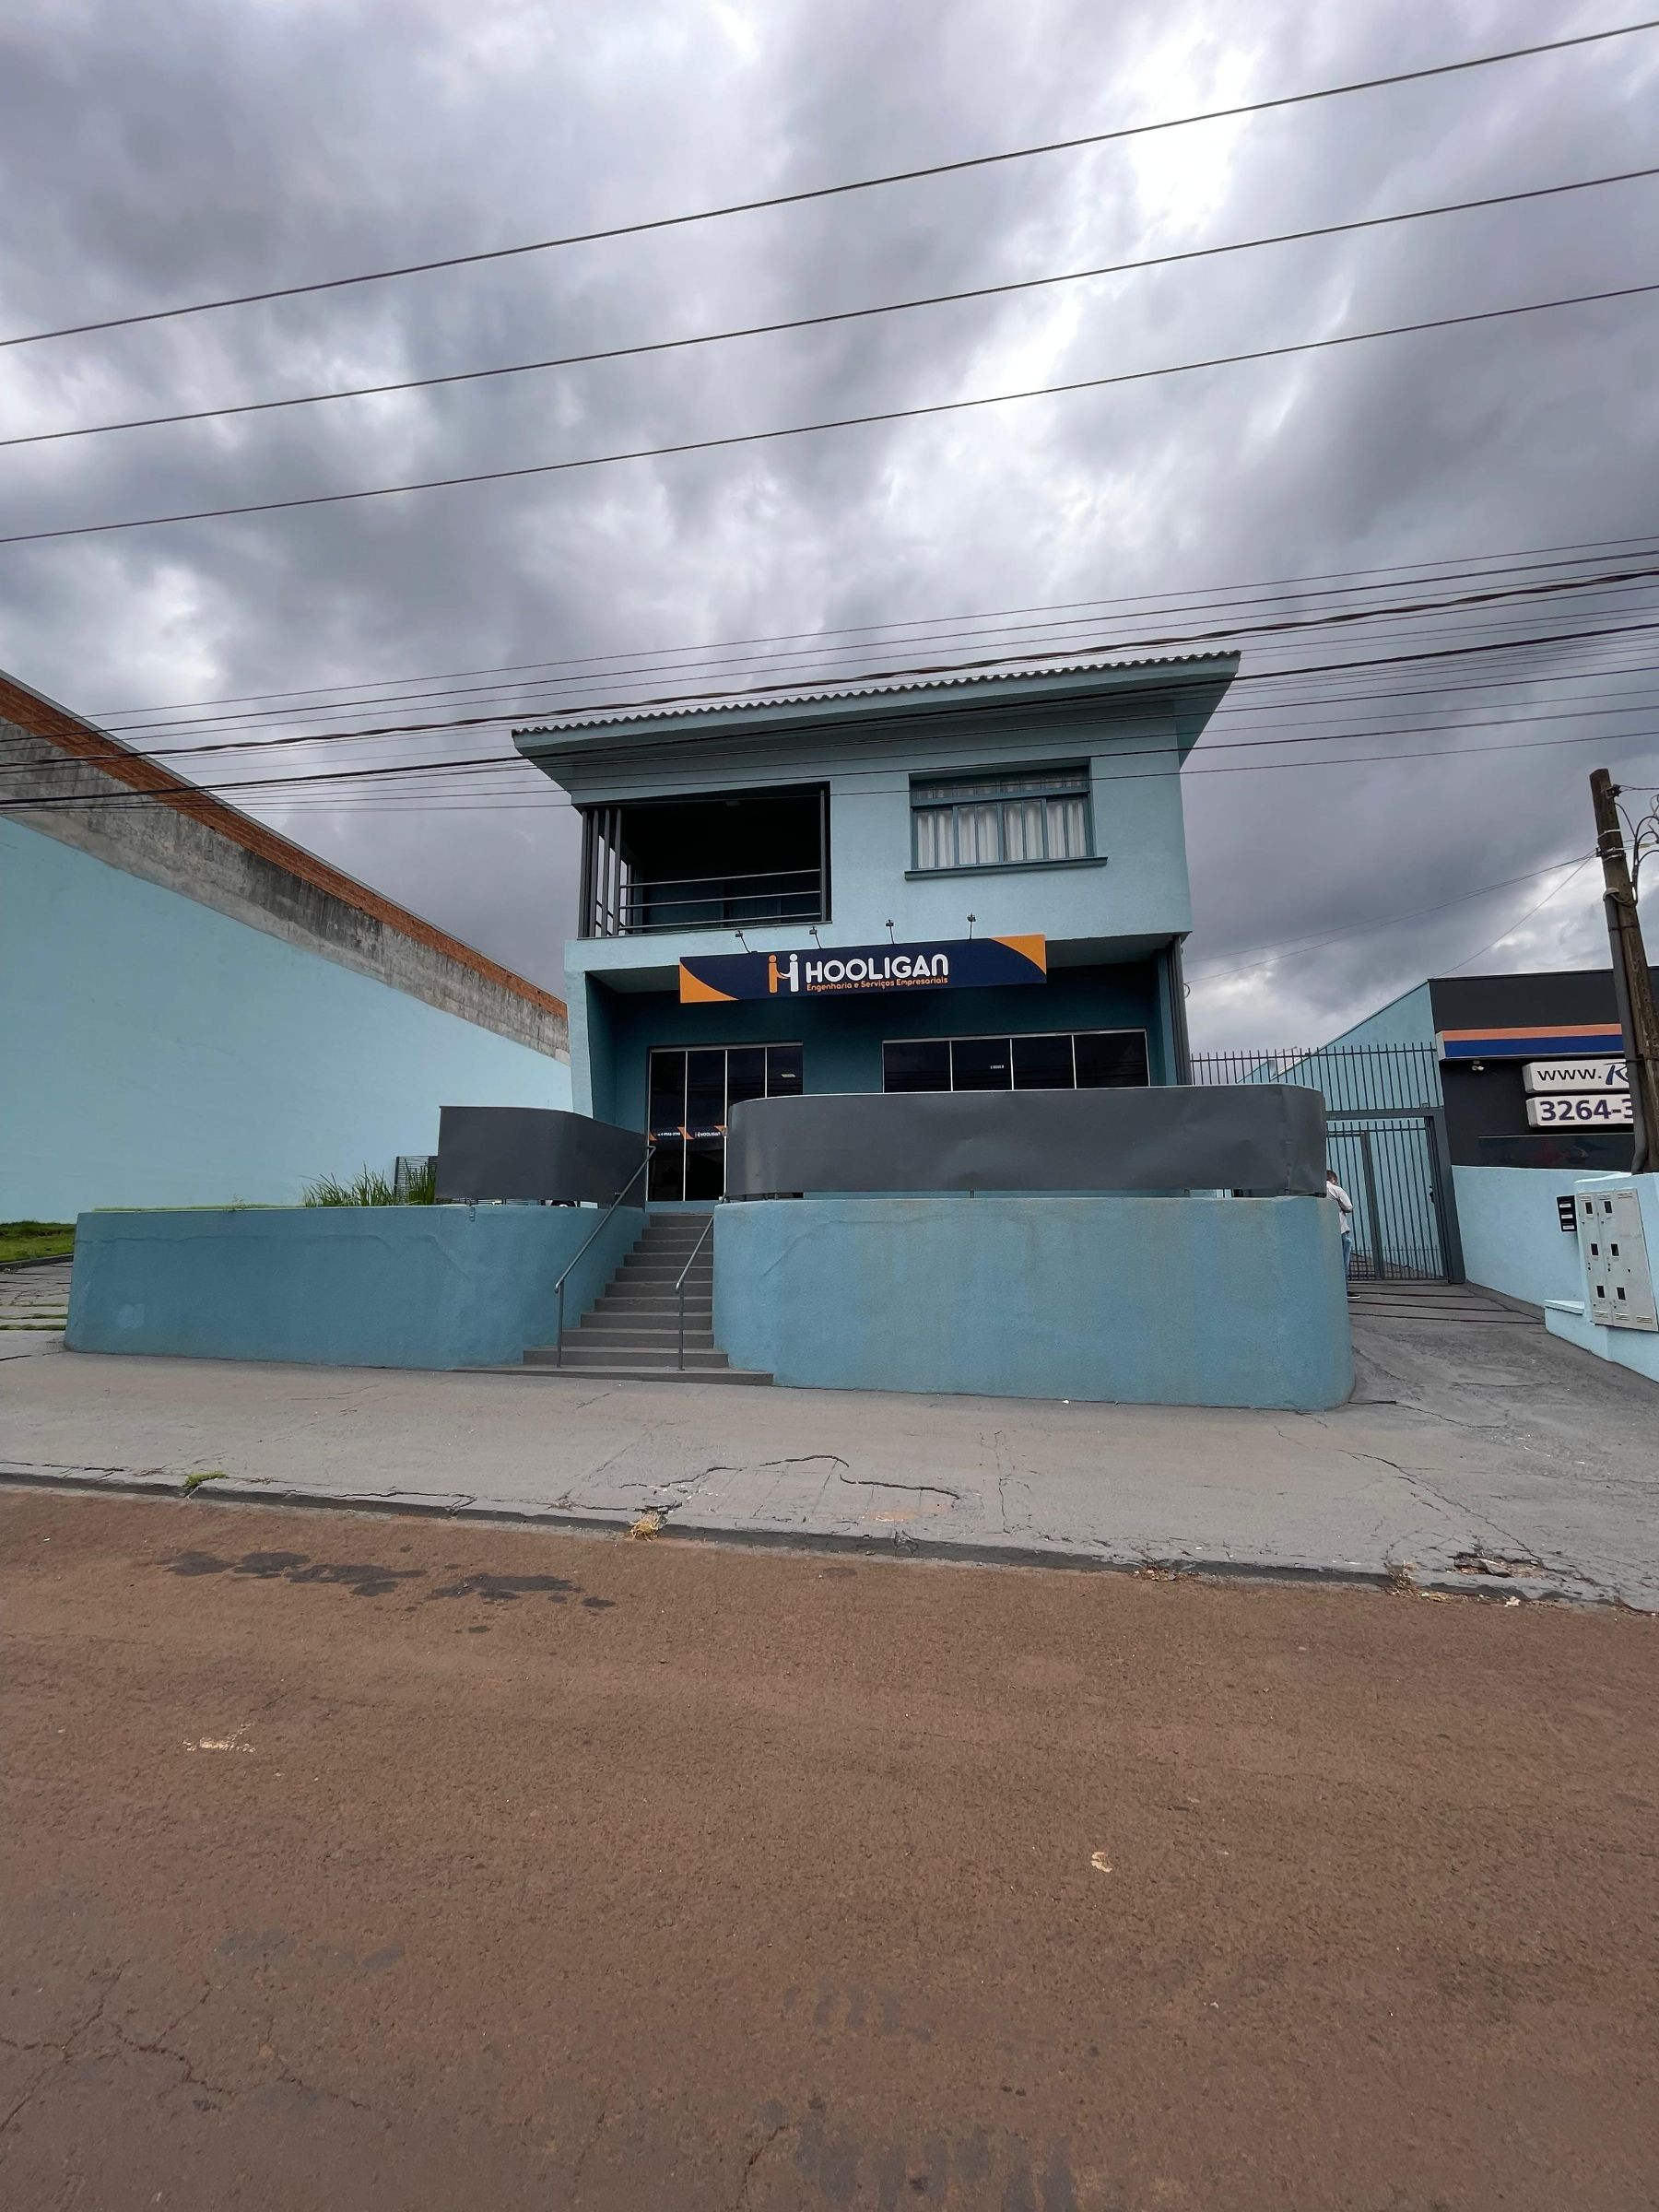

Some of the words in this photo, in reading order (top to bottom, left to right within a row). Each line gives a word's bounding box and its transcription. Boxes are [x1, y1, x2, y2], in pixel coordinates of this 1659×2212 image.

[806, 953, 949, 983] HOOLIGAN
[806, 982, 853, 993] Engenharia
[860, 980, 895, 990] Serviços
[896, 976, 948, 988] Empresariais
[1537, 1062, 1630, 1086] www.R
